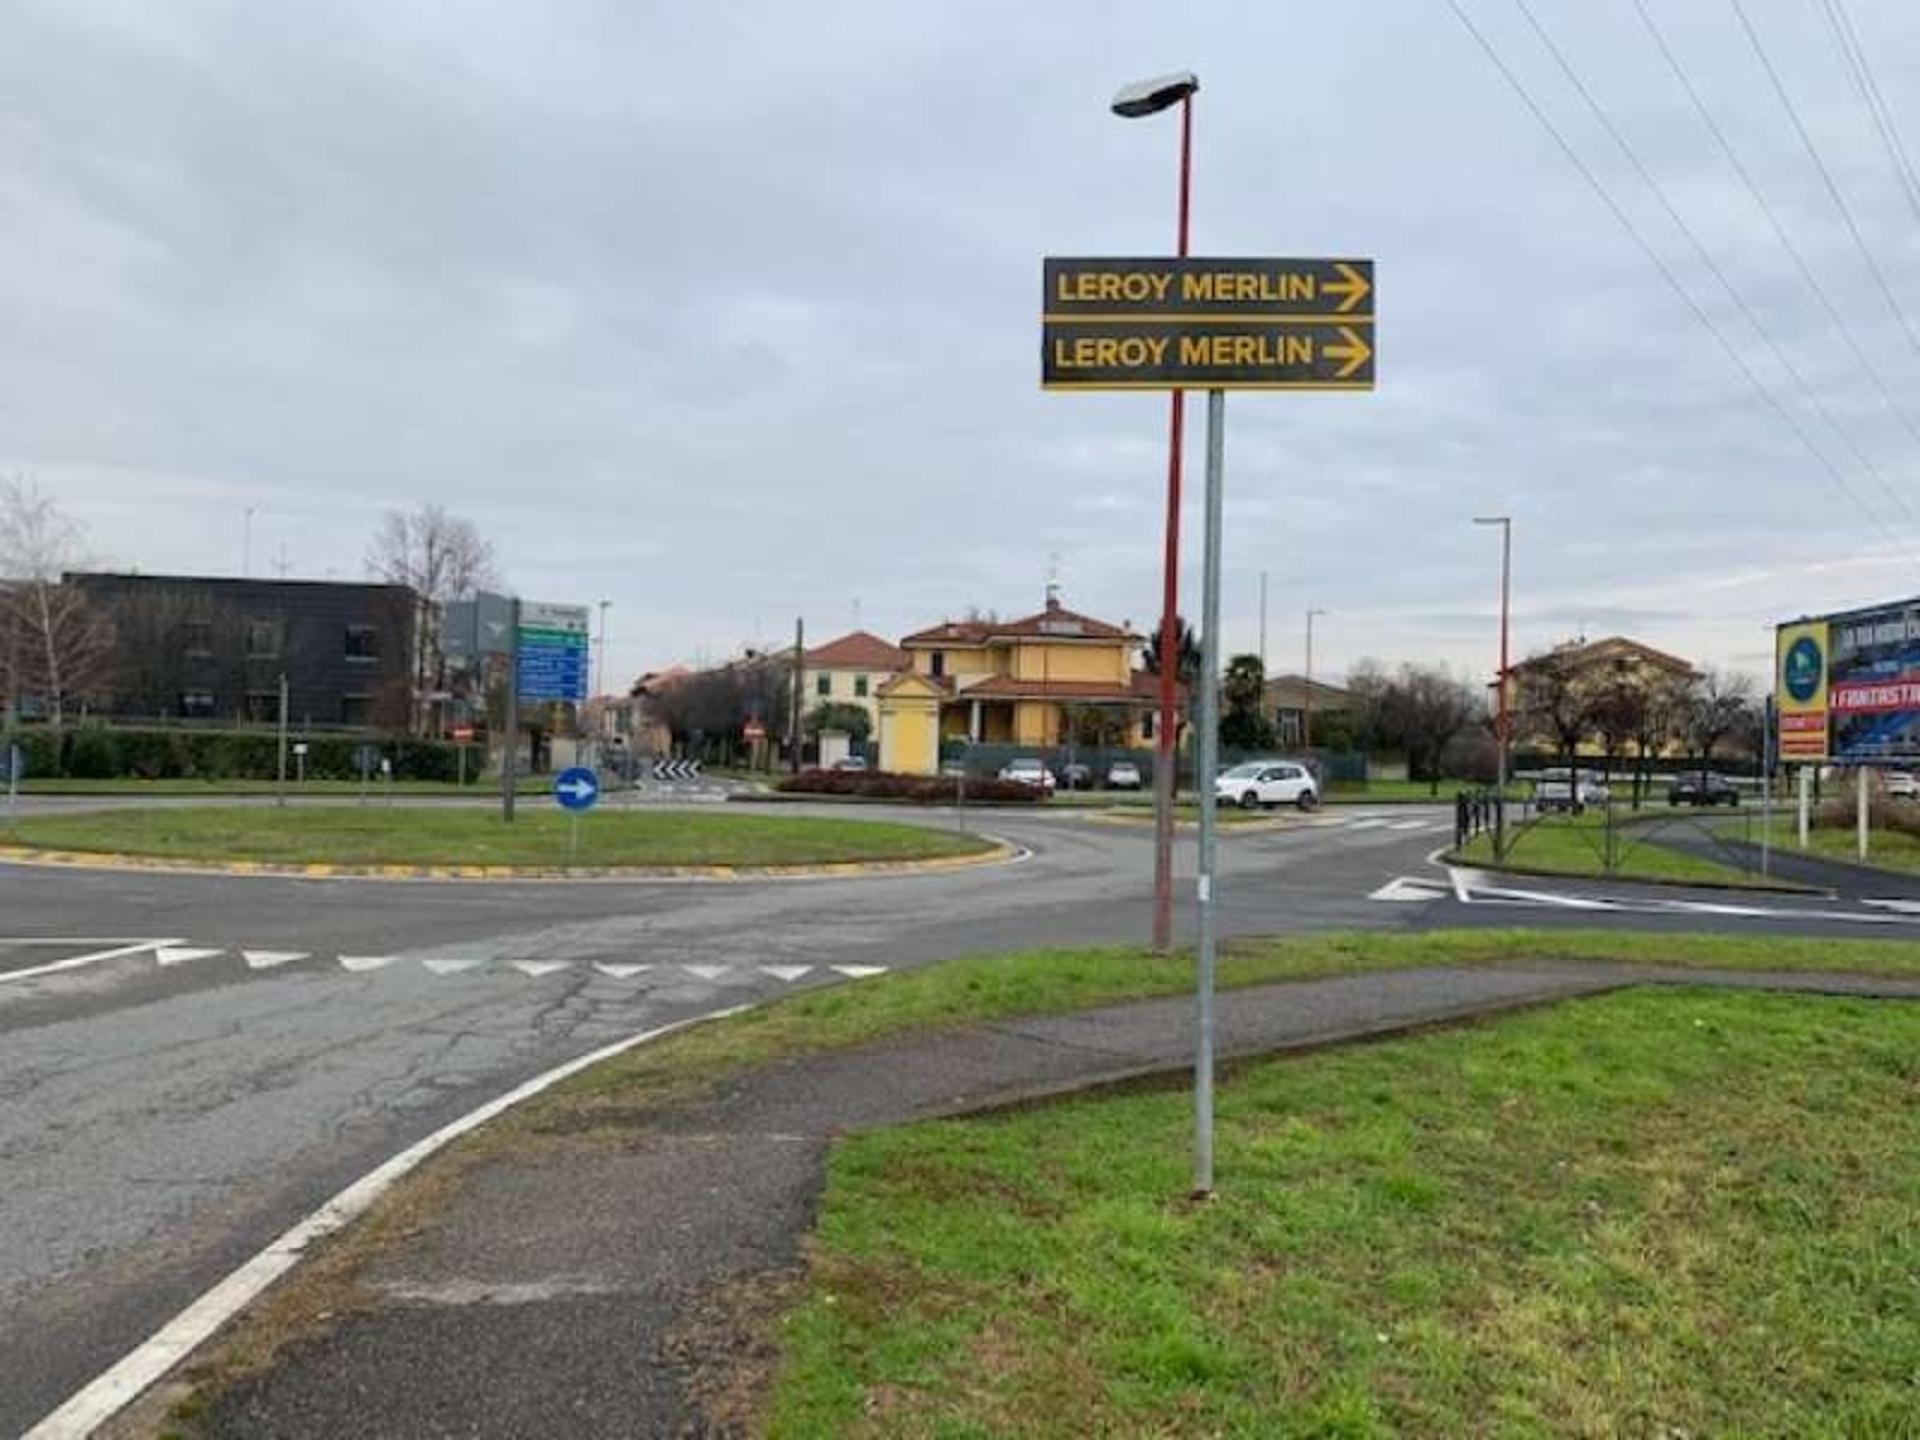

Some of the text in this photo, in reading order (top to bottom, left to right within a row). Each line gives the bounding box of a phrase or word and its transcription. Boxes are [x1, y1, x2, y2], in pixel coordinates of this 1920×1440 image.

[1057, 272, 1314, 301] LEROY MERLIN
[1055, 335, 1313, 368] LEROY MERLIN
